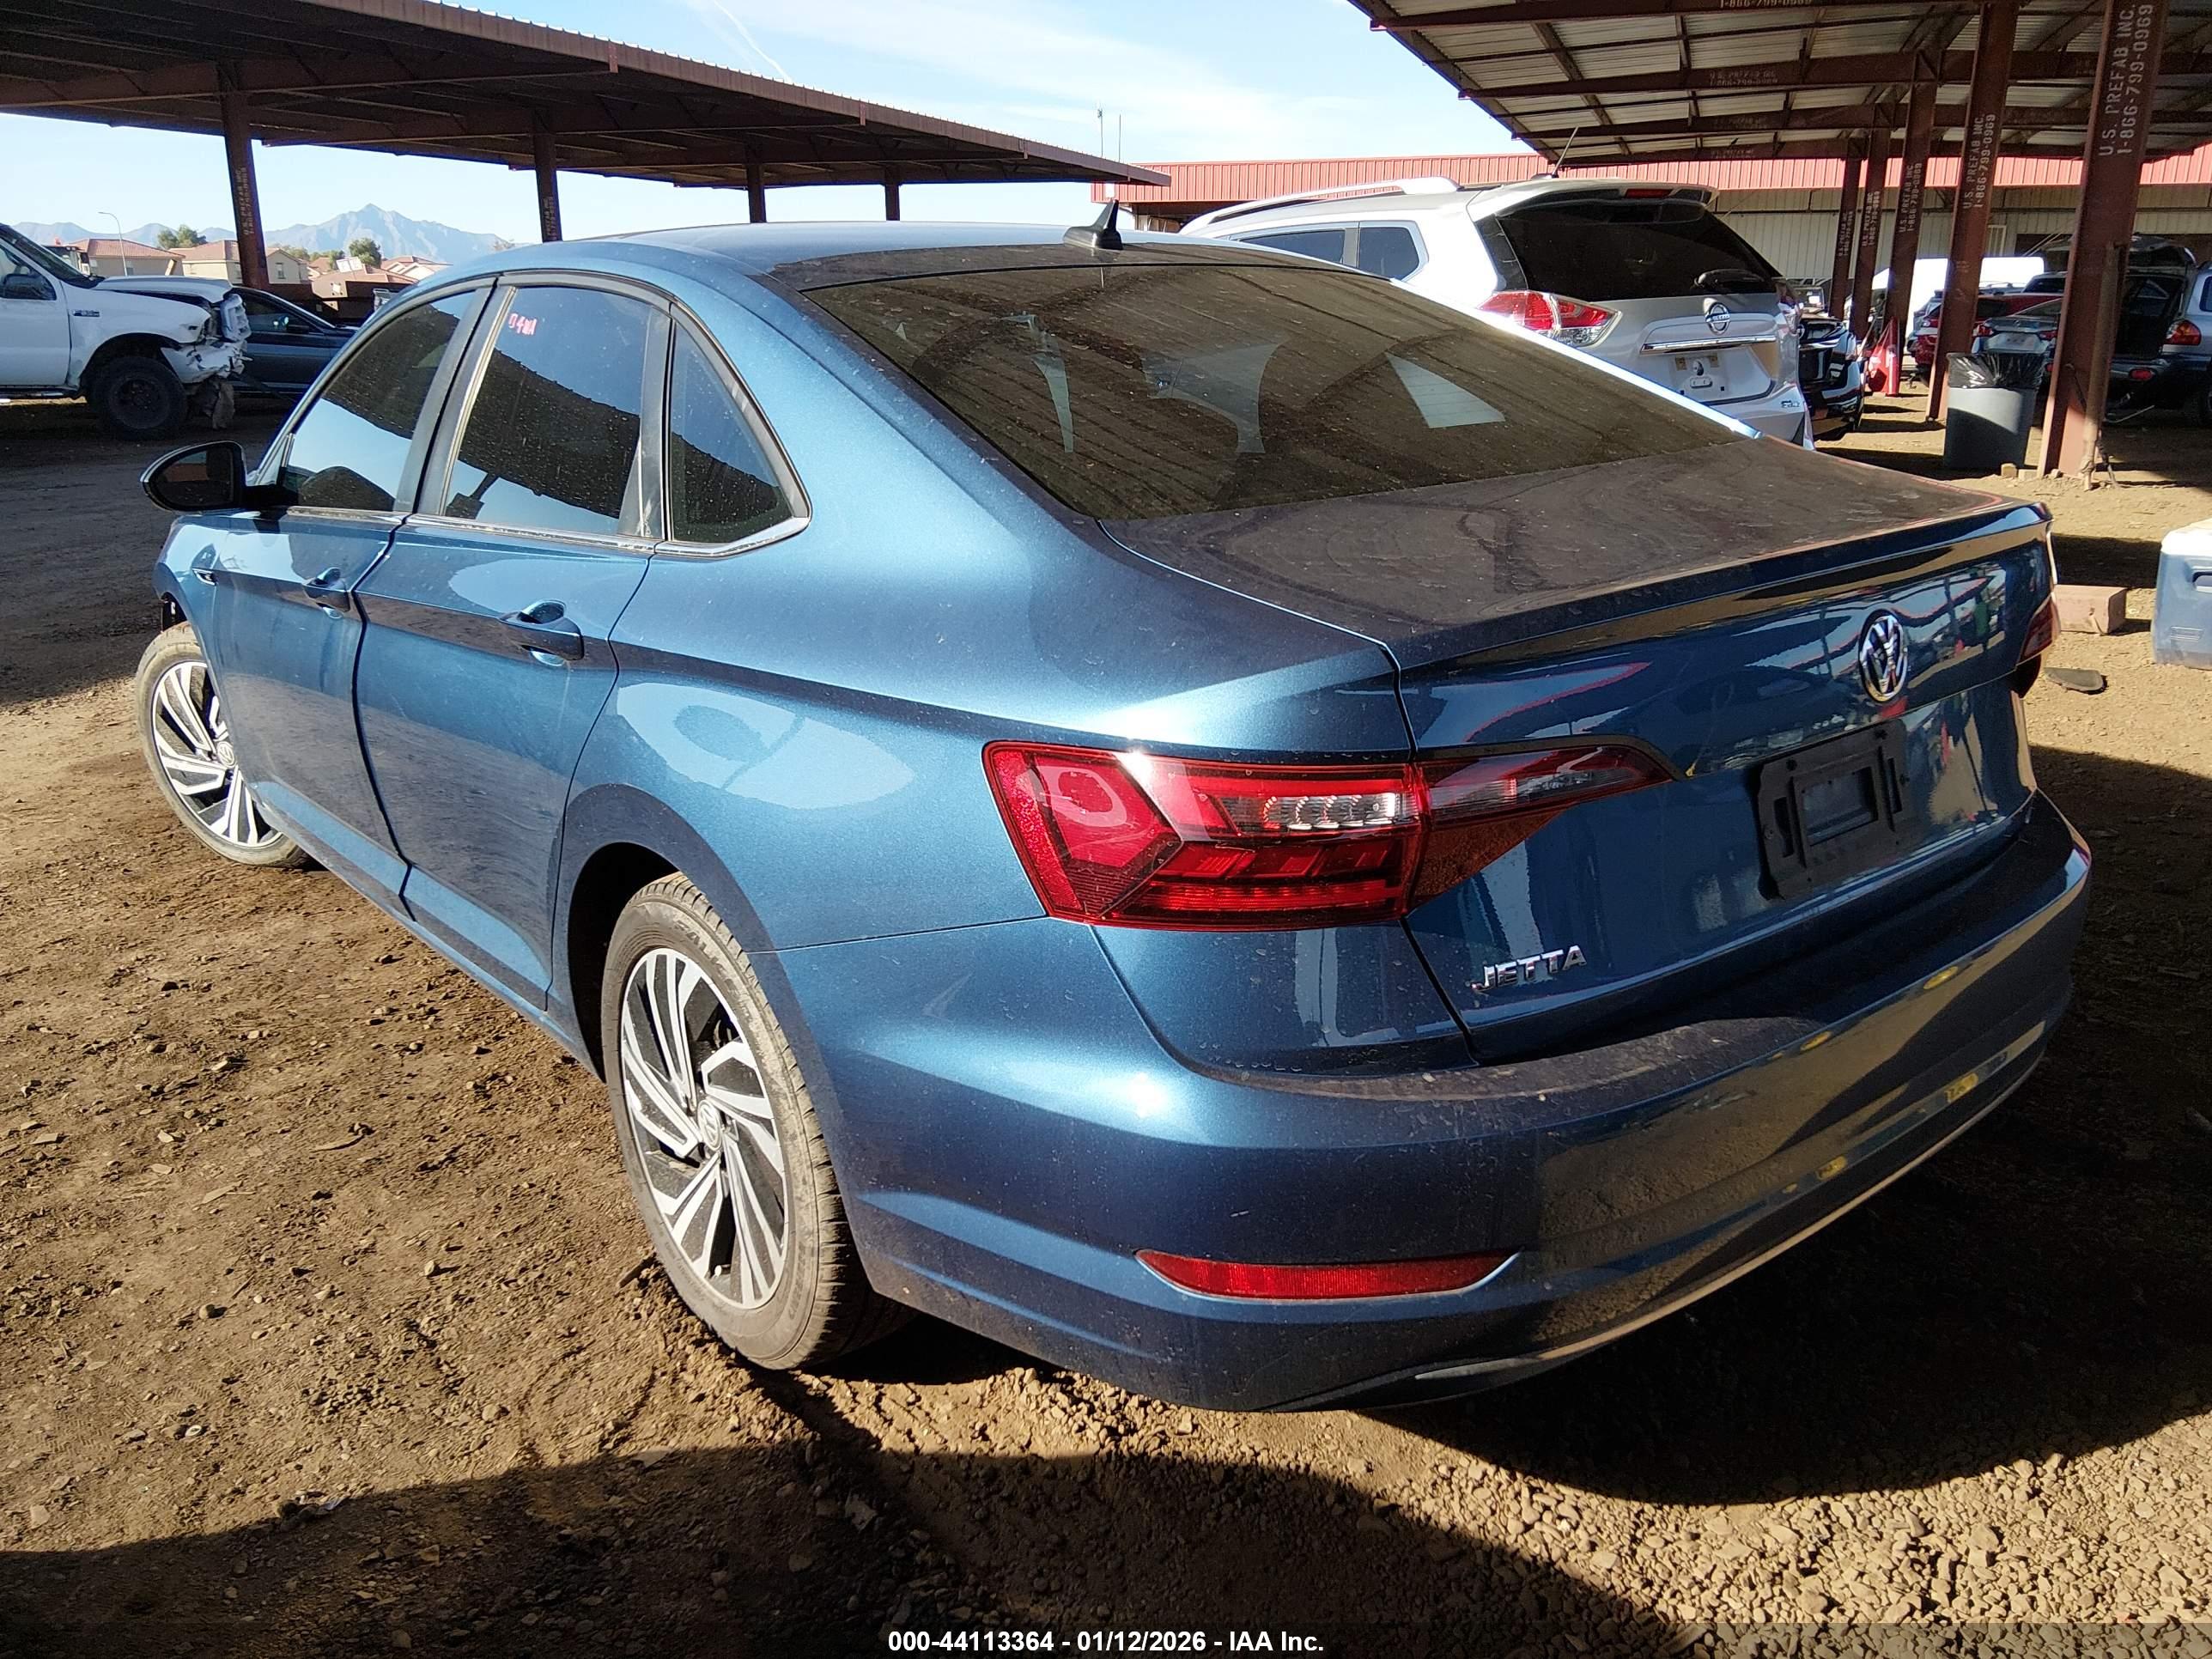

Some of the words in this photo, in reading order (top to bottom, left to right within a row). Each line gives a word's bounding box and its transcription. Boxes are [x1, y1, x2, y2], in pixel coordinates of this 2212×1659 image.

[2116, 4, 2136, 38] INC.
[2106, 46, 2129, 114] PREFAB
[2117, 4, 2153, 155] 1-866-799-0969
[1966, 140, 1980, 183] PREFAB
[1974, 113, 1996, 208] 1-866-799-0969
[2099, 124, 2117, 155] U.S.
[1471, 945, 1587, 994] JETTA
